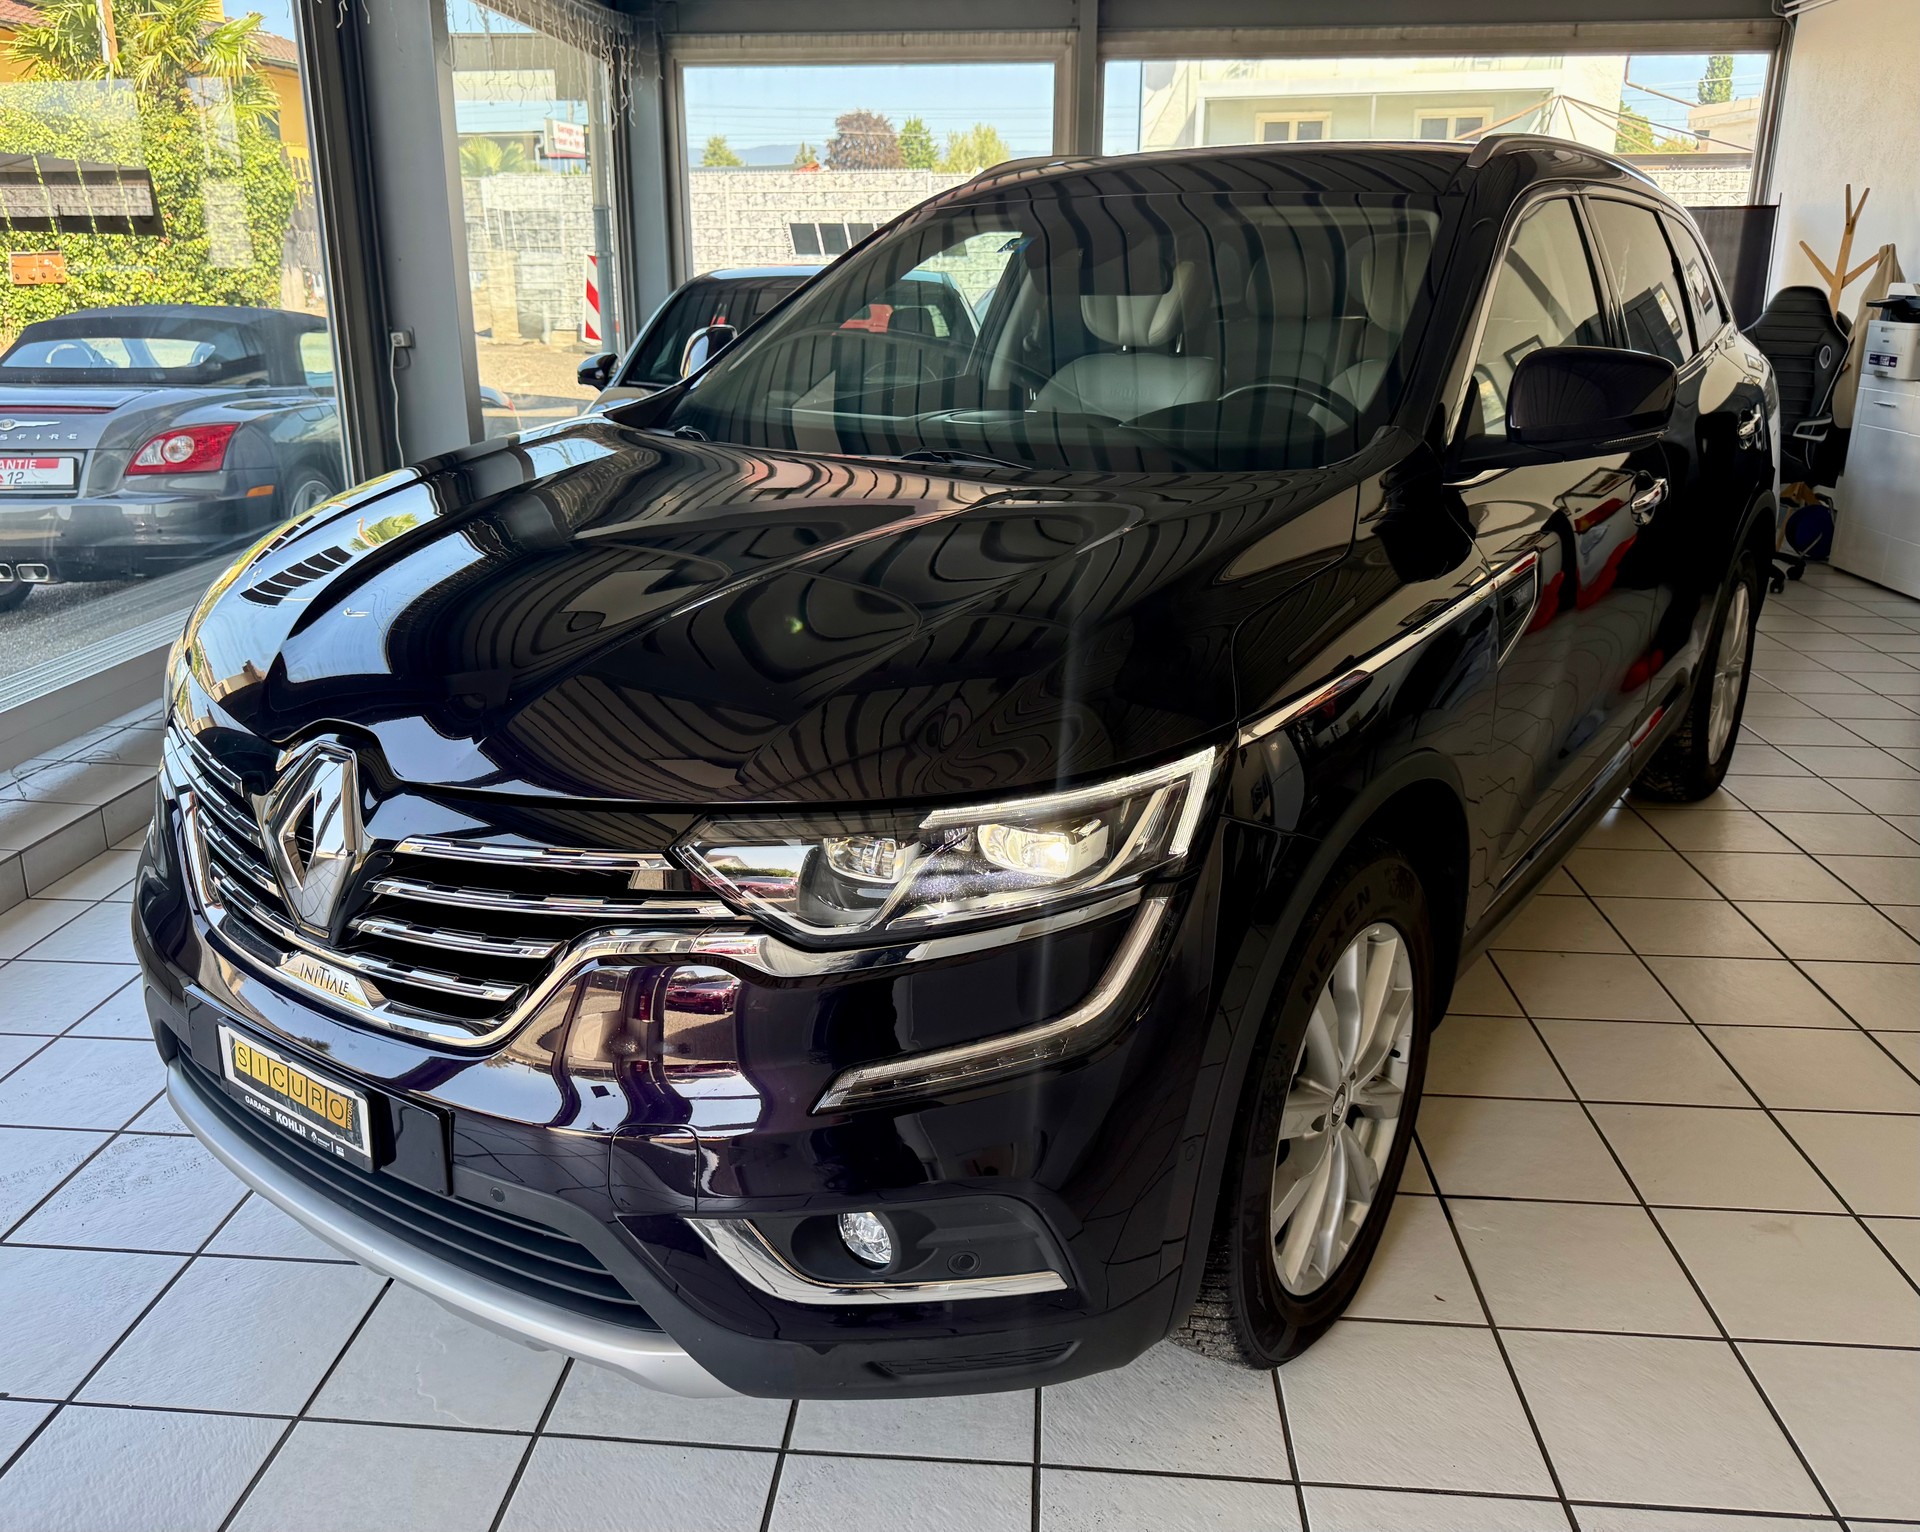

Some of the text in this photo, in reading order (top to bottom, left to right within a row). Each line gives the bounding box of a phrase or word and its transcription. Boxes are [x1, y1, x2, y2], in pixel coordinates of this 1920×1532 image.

[1301, 885, 1372, 1005] NEXEN
[300, 962, 350, 996] INITIALE
[237, 1046, 344, 1120] SICURO
[244, 1095, 271, 1116] GARAGE
